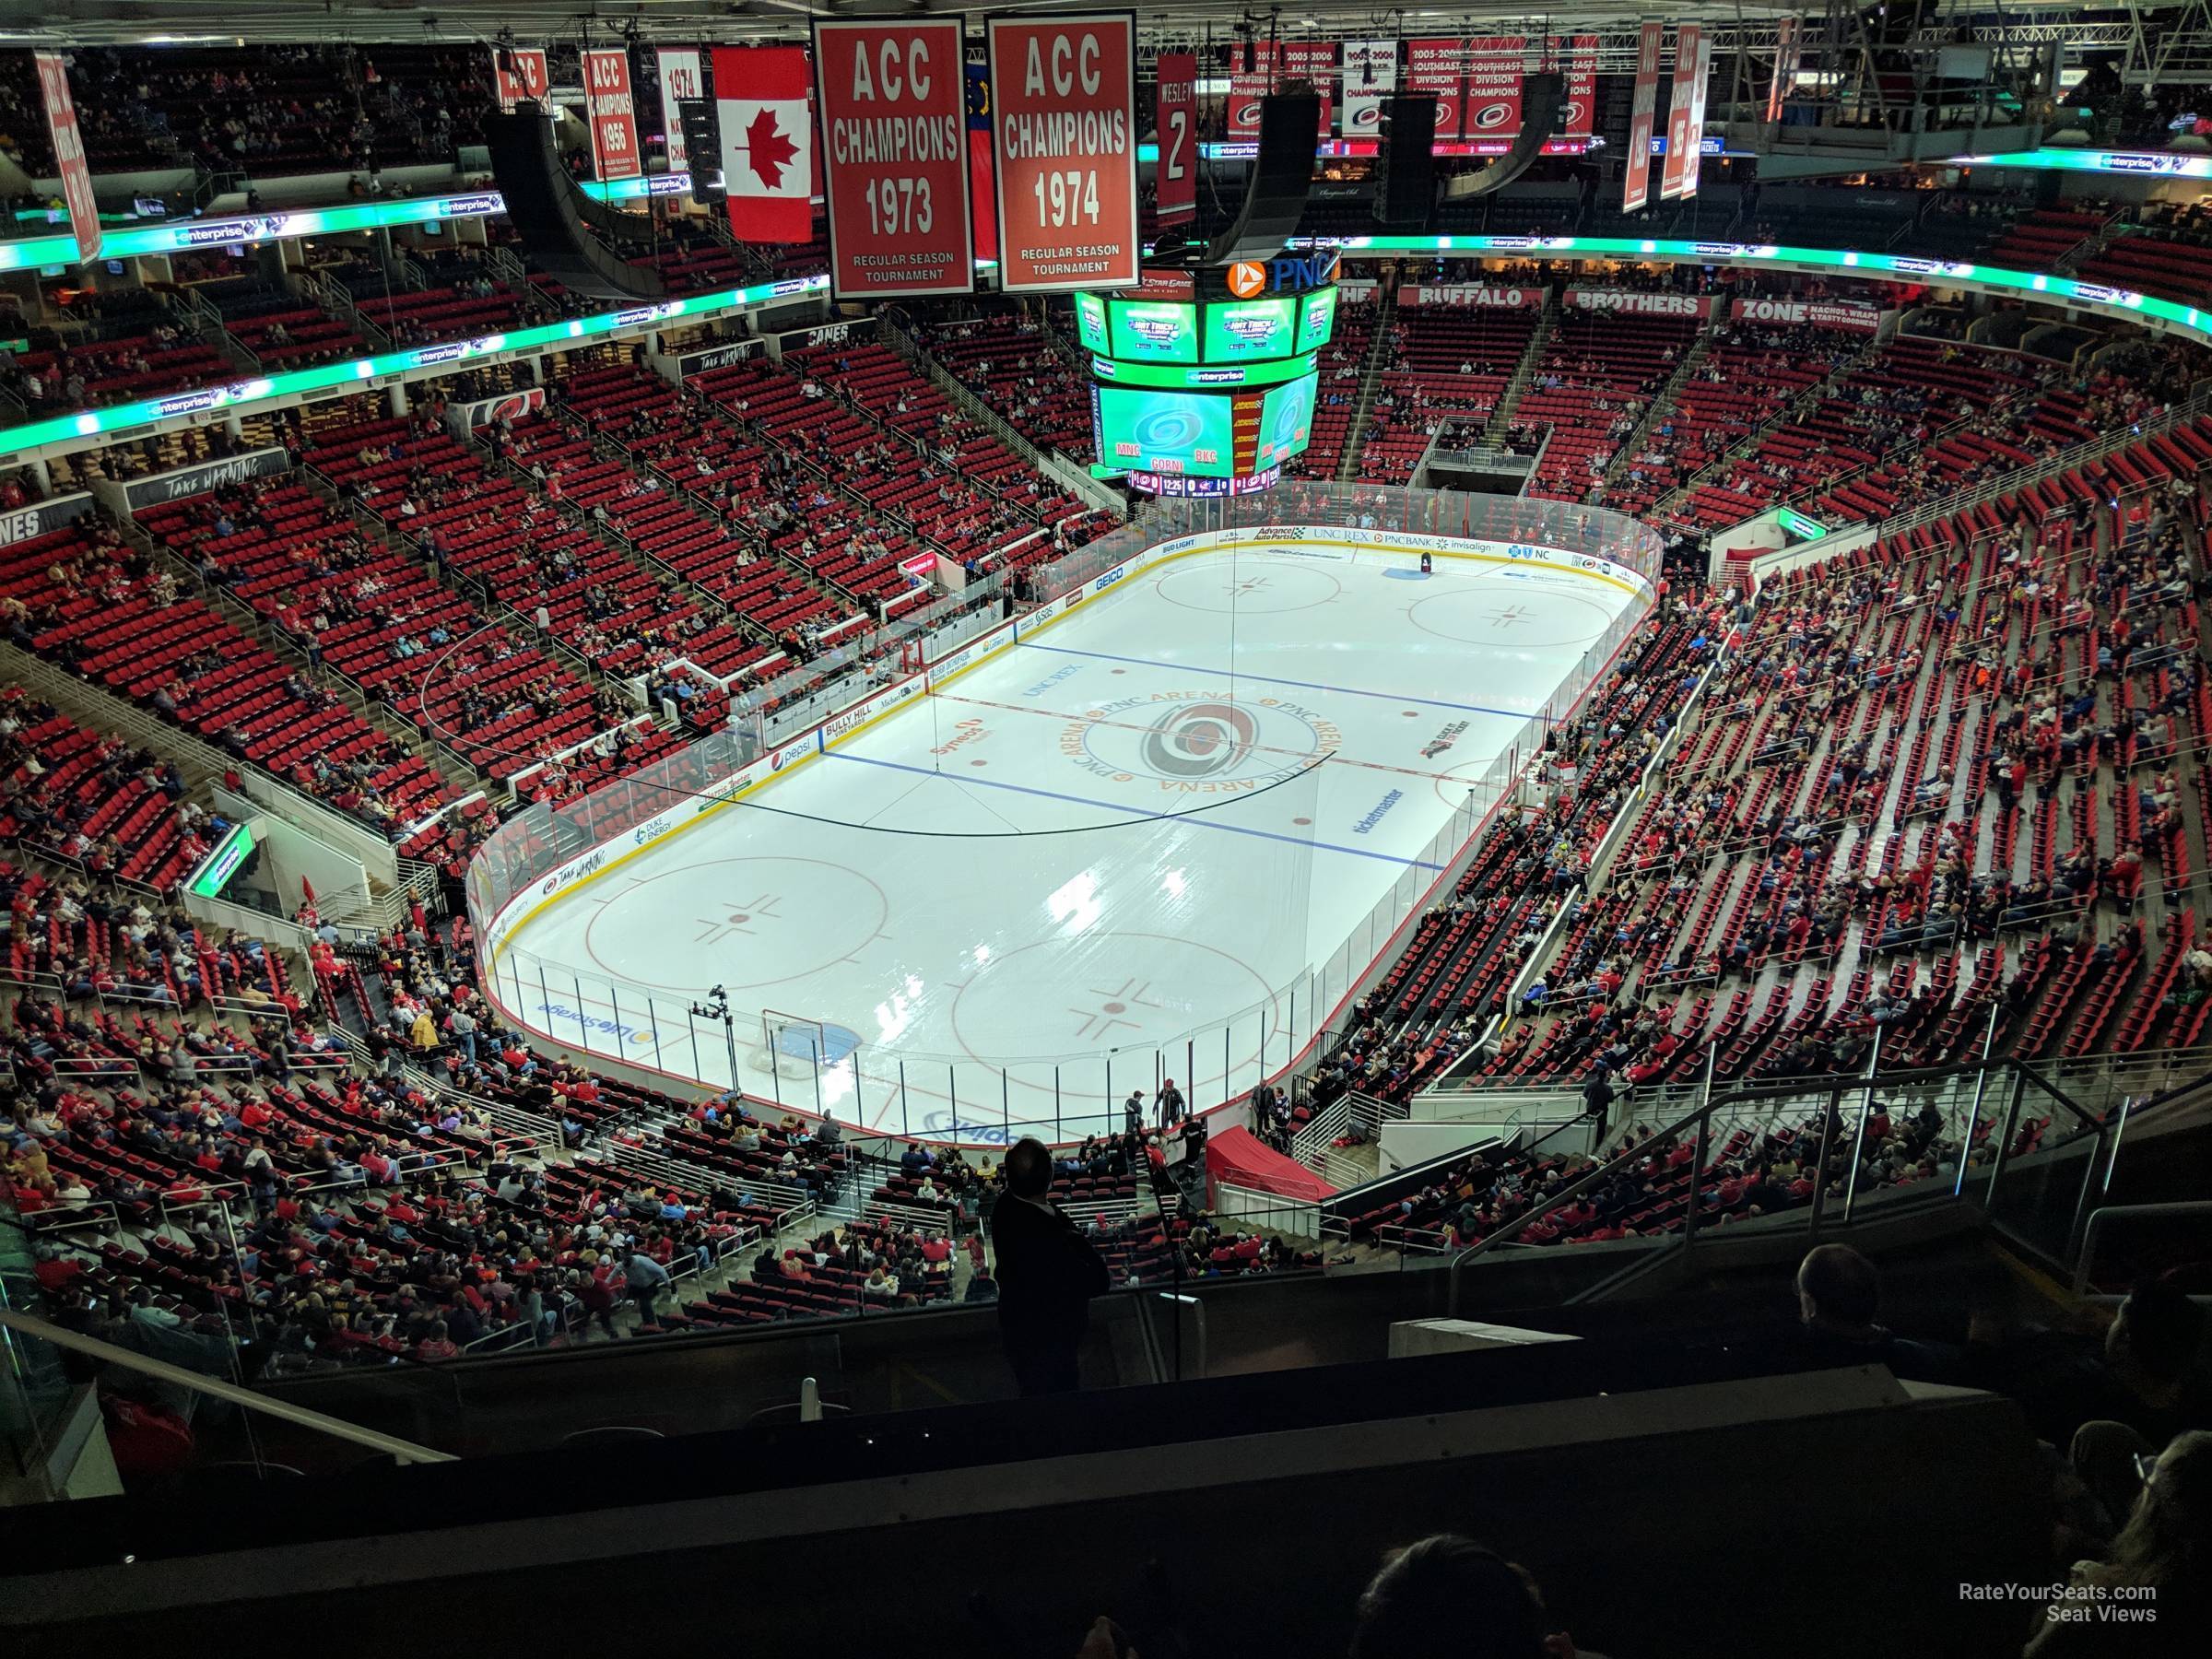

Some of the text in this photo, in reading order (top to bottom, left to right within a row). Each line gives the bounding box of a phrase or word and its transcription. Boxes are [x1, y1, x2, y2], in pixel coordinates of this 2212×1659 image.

[593, 57, 620, 88] ACC
[853, 38, 930, 101] ACC
[1025, 33, 1100, 96] ACC
[668, 68, 696, 100] 1974
[1416, 75, 1453, 84] DIVISION
[1476, 75, 1514, 84] DIVISION
[1161, 81, 1193, 103] WESLEY
[1469, 87, 1519, 97] CHAMPIONS
[589, 93, 631, 117] CHAMPIONS
[603, 123, 627, 151] 1956
[833, 114, 958, 164] CHAMPIONS
[1005, 109, 1125, 159] CHAMPIONS
[1168, 111, 1187, 180] 2
[2104, 156, 2152, 169] enterprise
[442, 199, 490, 211] enterprise
[866, 176, 933, 235] 1973
[1034, 170, 1100, 227] 1974
[177, 224, 243, 242] enterprise
[1487, 238, 1528, 247] enterprise
[1689, 243, 1731, 254] enterprise
[853, 253, 954, 267] REGULAR SEASON
[1021, 244, 1120, 260] REGULAR SEASON
[1033, 261, 1110, 275] TOURNAMENT
[1272, 254, 1330, 292] PNC
[1890, 259, 1931, 272] enterprise
[865, 269, 944, 283] TOURNAMENT
[1169, 278, 1193, 288] GAME
[770, 283, 801, 294] enterprise
[1418, 288, 1522, 305] BUFFALO
[2074, 287, 2111, 300] enterprise
[1576, 292, 1698, 314] BROTHERS
[1741, 300, 1807, 322] ZONE
[612, 311, 649, 324] enterprise
[1810, 305, 1879, 320] NACHOS, WRAPS
[1817, 314, 1841, 323] TASTY
[808, 325, 849, 347] CANES
[413, 348, 459, 363] enterprise
[700, 356, 719, 371] TAKE
[1190, 371, 1244, 382] enterprise
[152, 396, 211, 415] enterprise
[1116, 443, 1218, 463] MNC BKC
[165, 457, 261, 500] TAKE WARNING
[1164, 479, 1182, 490] 12:25
[1258, 527, 1291, 535] Advance
[1314, 529, 1369, 542] UNC REX
[1175, 539, 1195, 549] LIGHT
[1451, 540, 1491, 553] invisalign
[1535, 550, 1549, 560] NC
[1096, 567, 1124, 591] GEICO
[1023, 664, 1084, 698] UNC REX
[881, 692, 901, 709] Michael
[1100, 690, 1236, 712] PNC ARENA
[826, 703, 872, 737] BULLY HILL
[834, 717, 865, 738] VINEYARDS
[1276, 701, 1342, 754] PNC ARENA
[929, 725, 984, 756] Syneos
[784, 740, 811, 766] pepsi
[1060, 722, 1116, 778] PNC ARENA
[1159, 780, 1254, 793] ARENA
[1353, 788, 1405, 834] ticketmaster
[645, 817, 663, 832] DUKE
[647, 821, 672, 841] ENERGY
[557, 867, 576, 883] TAKE
